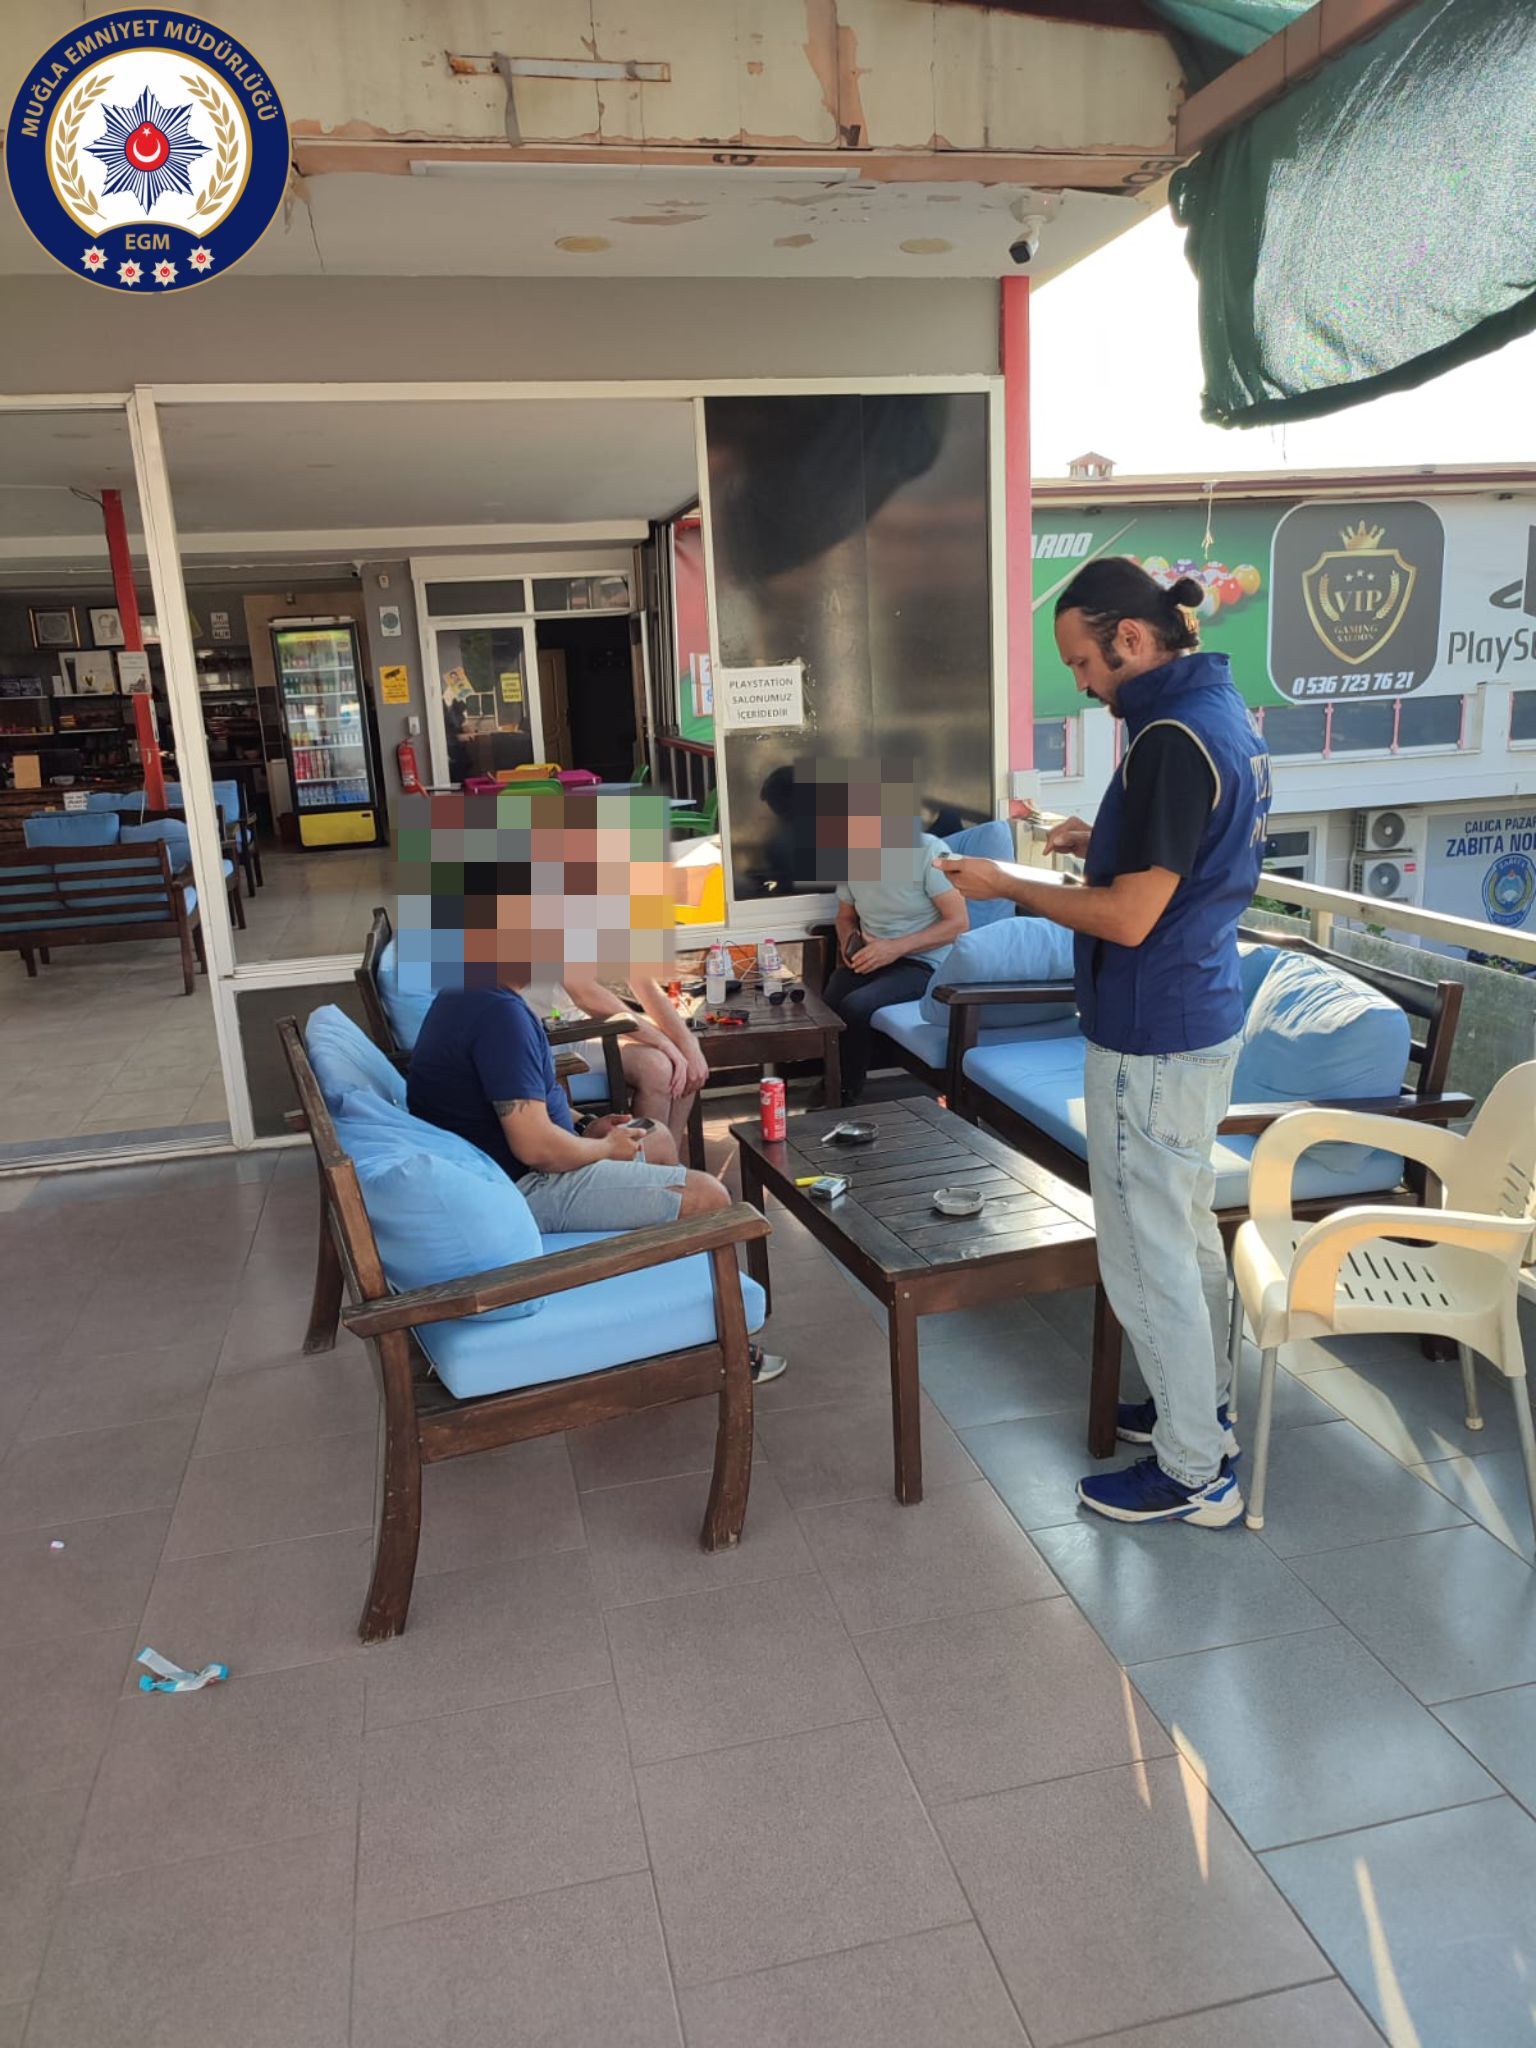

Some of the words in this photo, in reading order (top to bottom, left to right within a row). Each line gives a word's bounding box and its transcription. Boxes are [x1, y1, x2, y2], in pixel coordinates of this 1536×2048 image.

[1335, 590, 1382, 613] VIP
[1292, 677, 1305, 696] 0
[1307, 675, 1339, 695] 536
[1340, 673, 1371, 692] 723
[1372, 672, 1394, 690] 76
[1394, 671, 1415, 689] 21
[732, 693, 792, 704] SALONUMUZ
[1446, 835, 1504, 858] ZABITA
